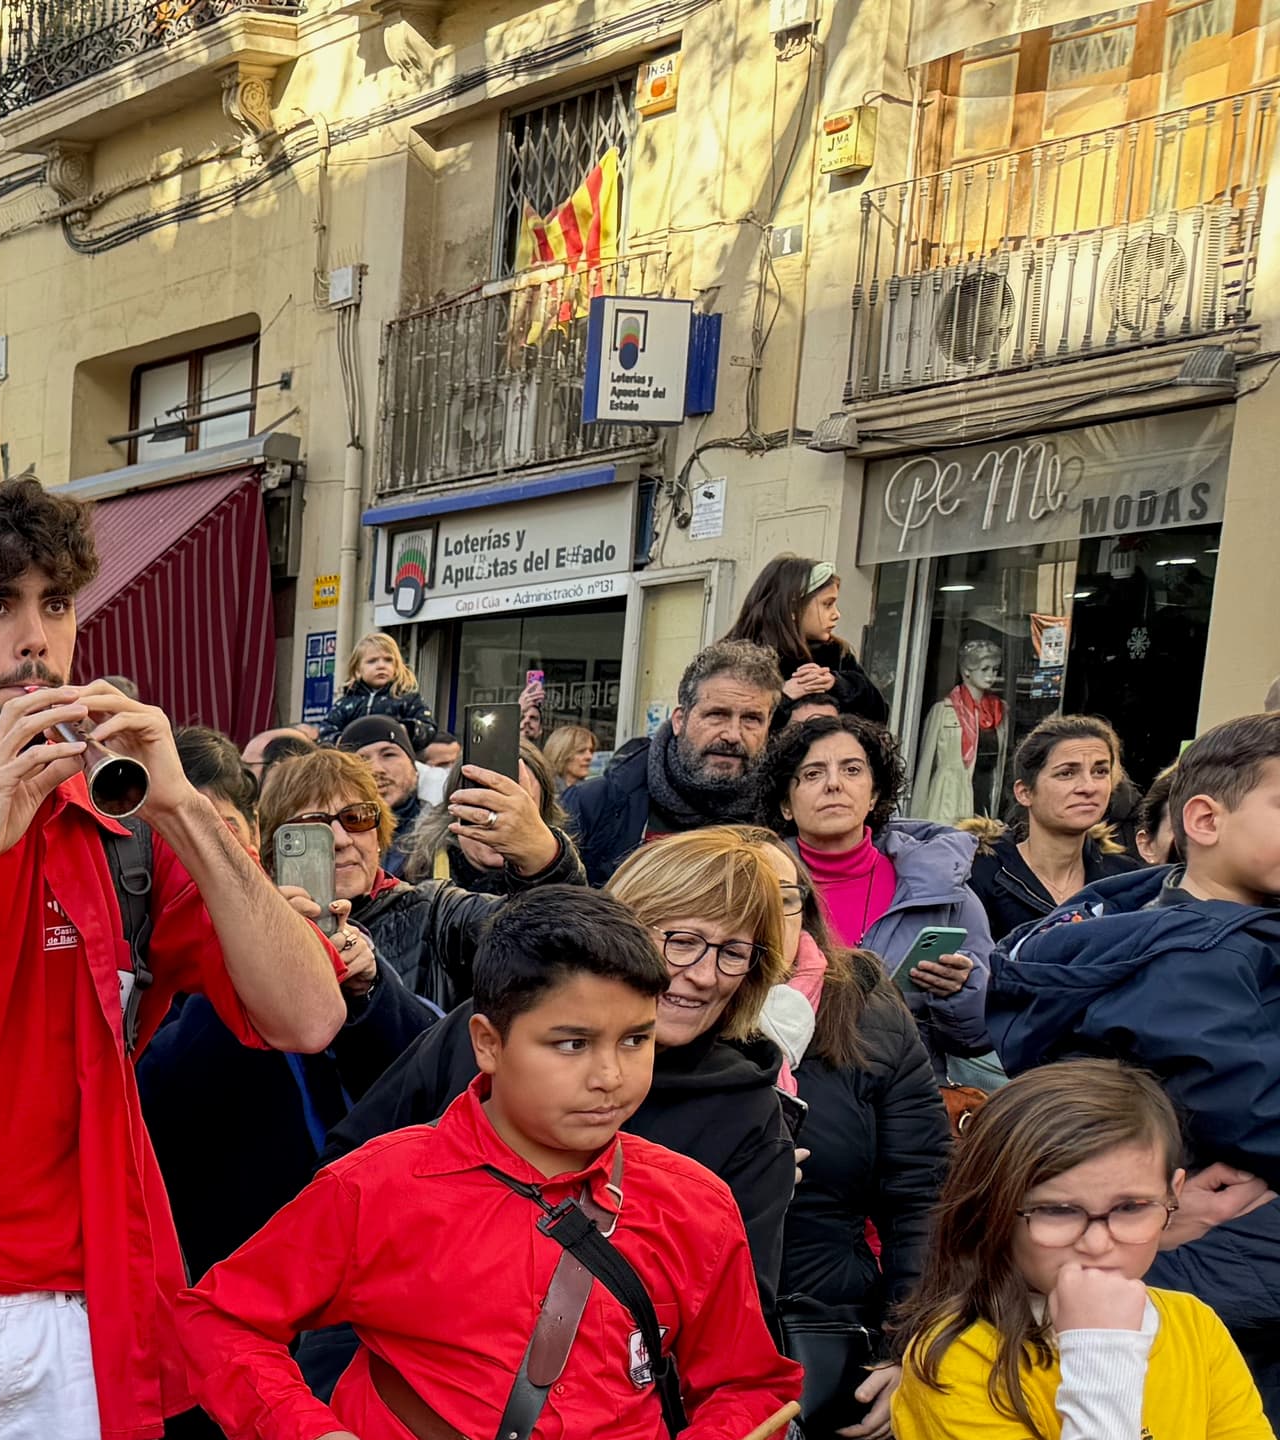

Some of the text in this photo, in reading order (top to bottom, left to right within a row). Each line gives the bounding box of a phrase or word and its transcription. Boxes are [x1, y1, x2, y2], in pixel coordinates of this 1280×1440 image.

[782, 228, 792, 254] 1
[610, 386, 666, 399] Apuestas del
[647, 376, 654, 388] y
[609, 400, 640, 412] Estado
[1079, 482, 1211, 534] MODAS
[443, 528, 527, 557] Loterías y
[442, 556, 517, 589] Aputas
[523, 550, 549, 573] del
[455, 599, 474, 616] Cap
[513, 586, 583, 608] Administració
